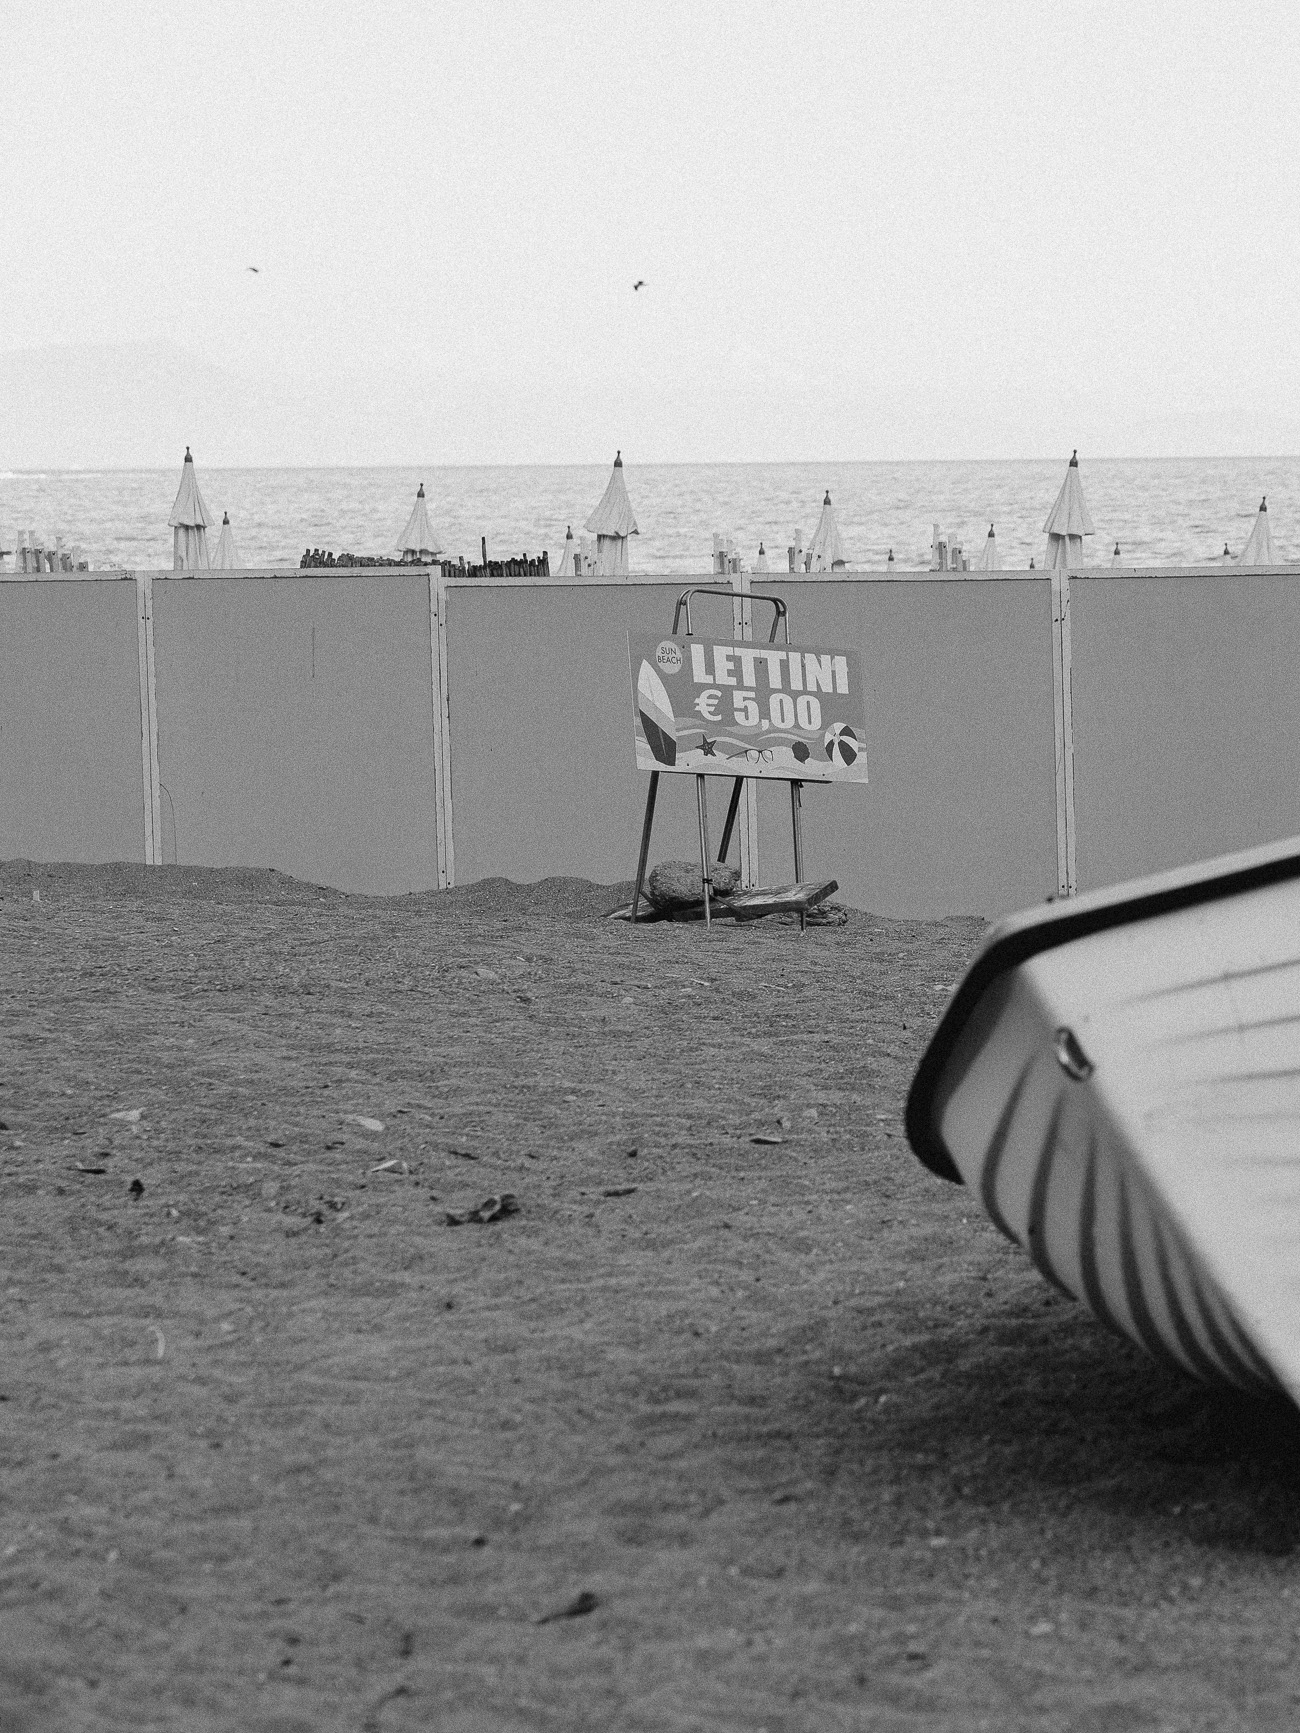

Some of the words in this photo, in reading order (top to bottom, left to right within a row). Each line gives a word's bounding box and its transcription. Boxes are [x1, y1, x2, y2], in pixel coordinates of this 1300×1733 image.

[657, 655, 682, 665] BEACH
[661, 646, 677, 655] SUN
[690, 643, 849, 694] LETTINI
[693, 689, 722, 721] €
[732, 690, 822, 731] 5,00
